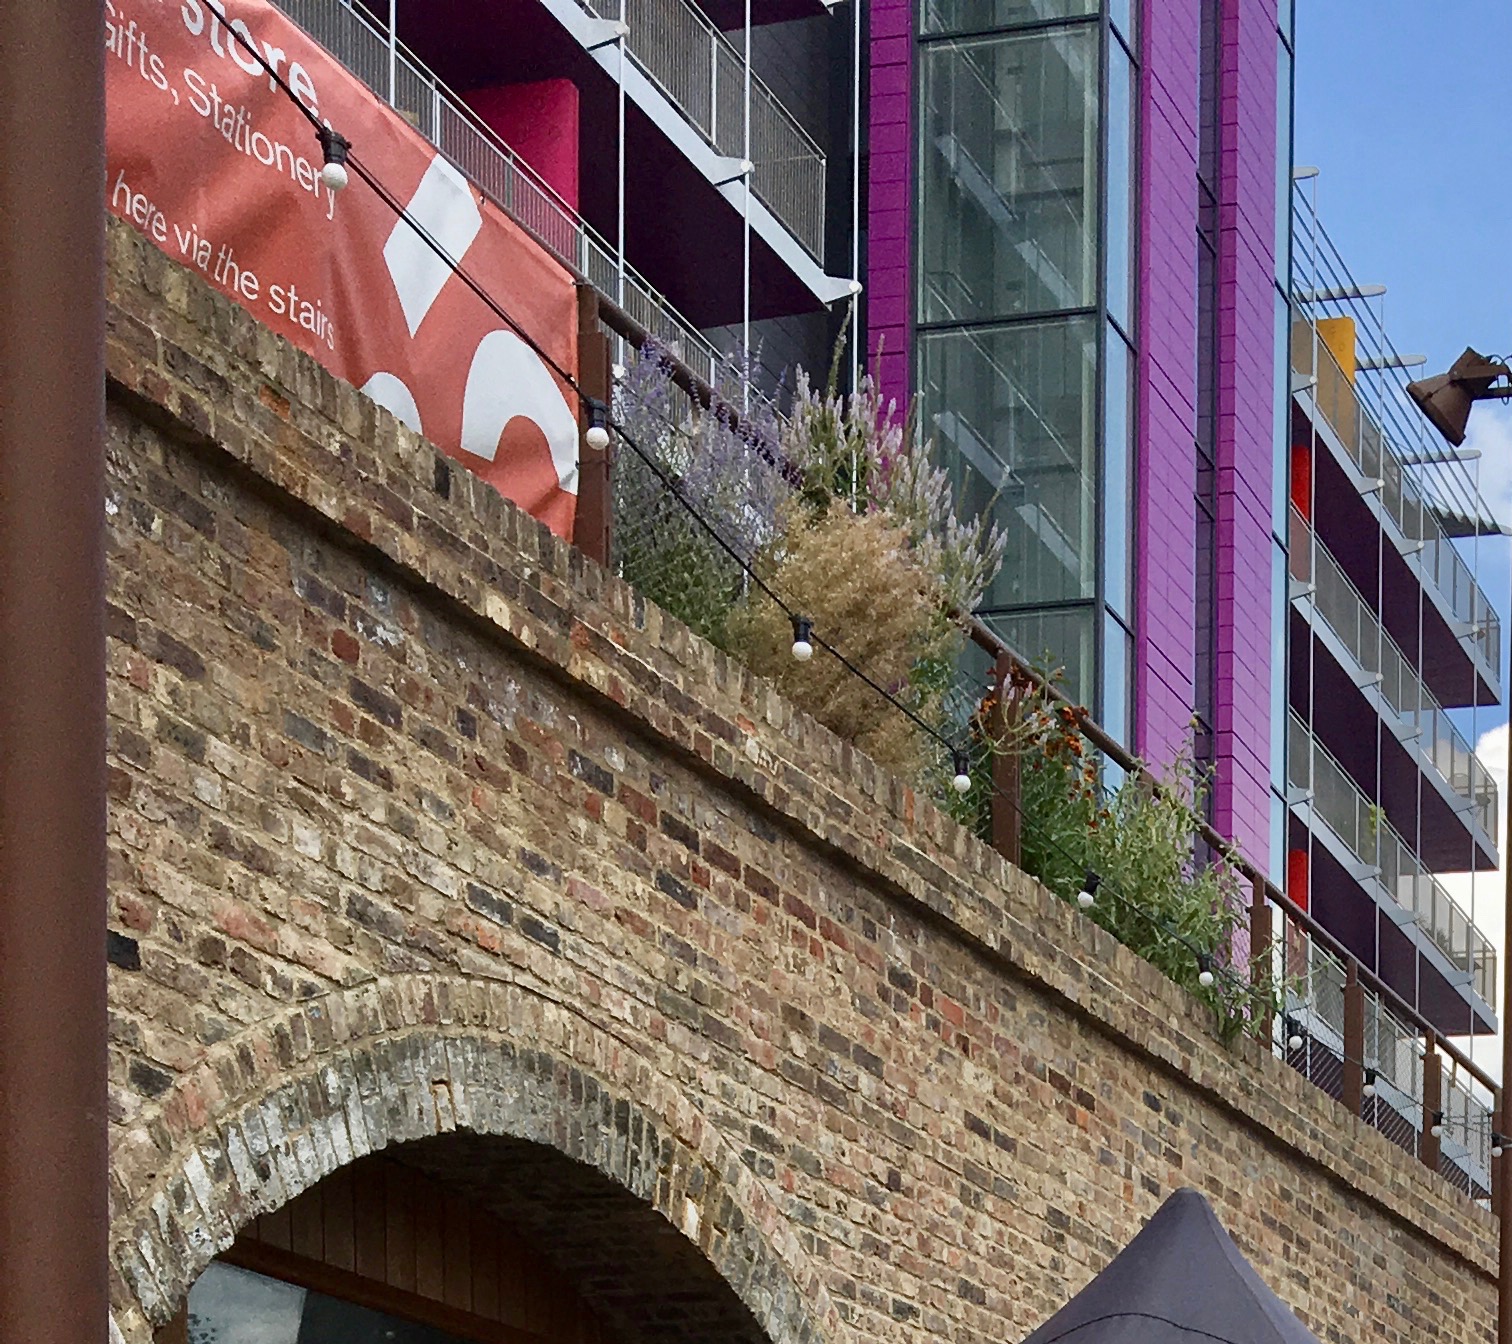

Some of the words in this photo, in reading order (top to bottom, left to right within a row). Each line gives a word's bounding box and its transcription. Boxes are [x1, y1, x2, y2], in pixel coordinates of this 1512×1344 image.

[111, 168, 168, 242] here
[173, 223, 212, 272] via
[213, 243, 260, 300] the
[268, 284, 335, 351] stairs
